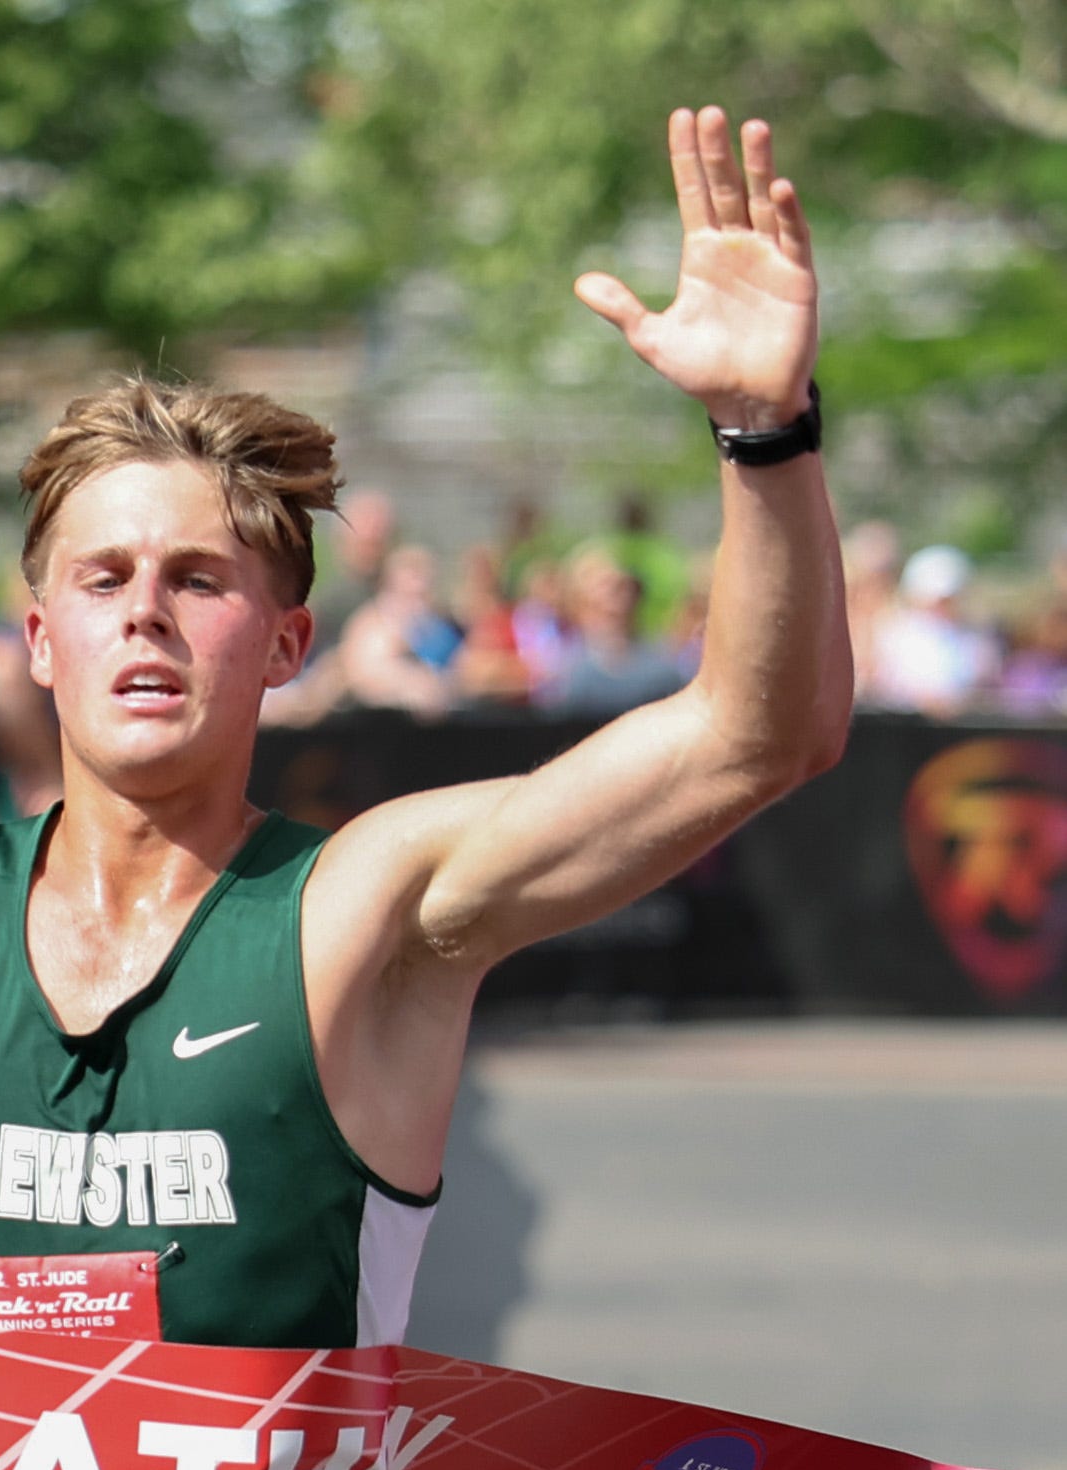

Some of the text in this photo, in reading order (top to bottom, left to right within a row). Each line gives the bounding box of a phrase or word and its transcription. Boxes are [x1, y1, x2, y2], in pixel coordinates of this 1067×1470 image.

[16, 1270, 87, 1287] ST. JUDE
[58, 1291, 132, 1313] Roll
[51, 1315, 115, 1328] SERIES
